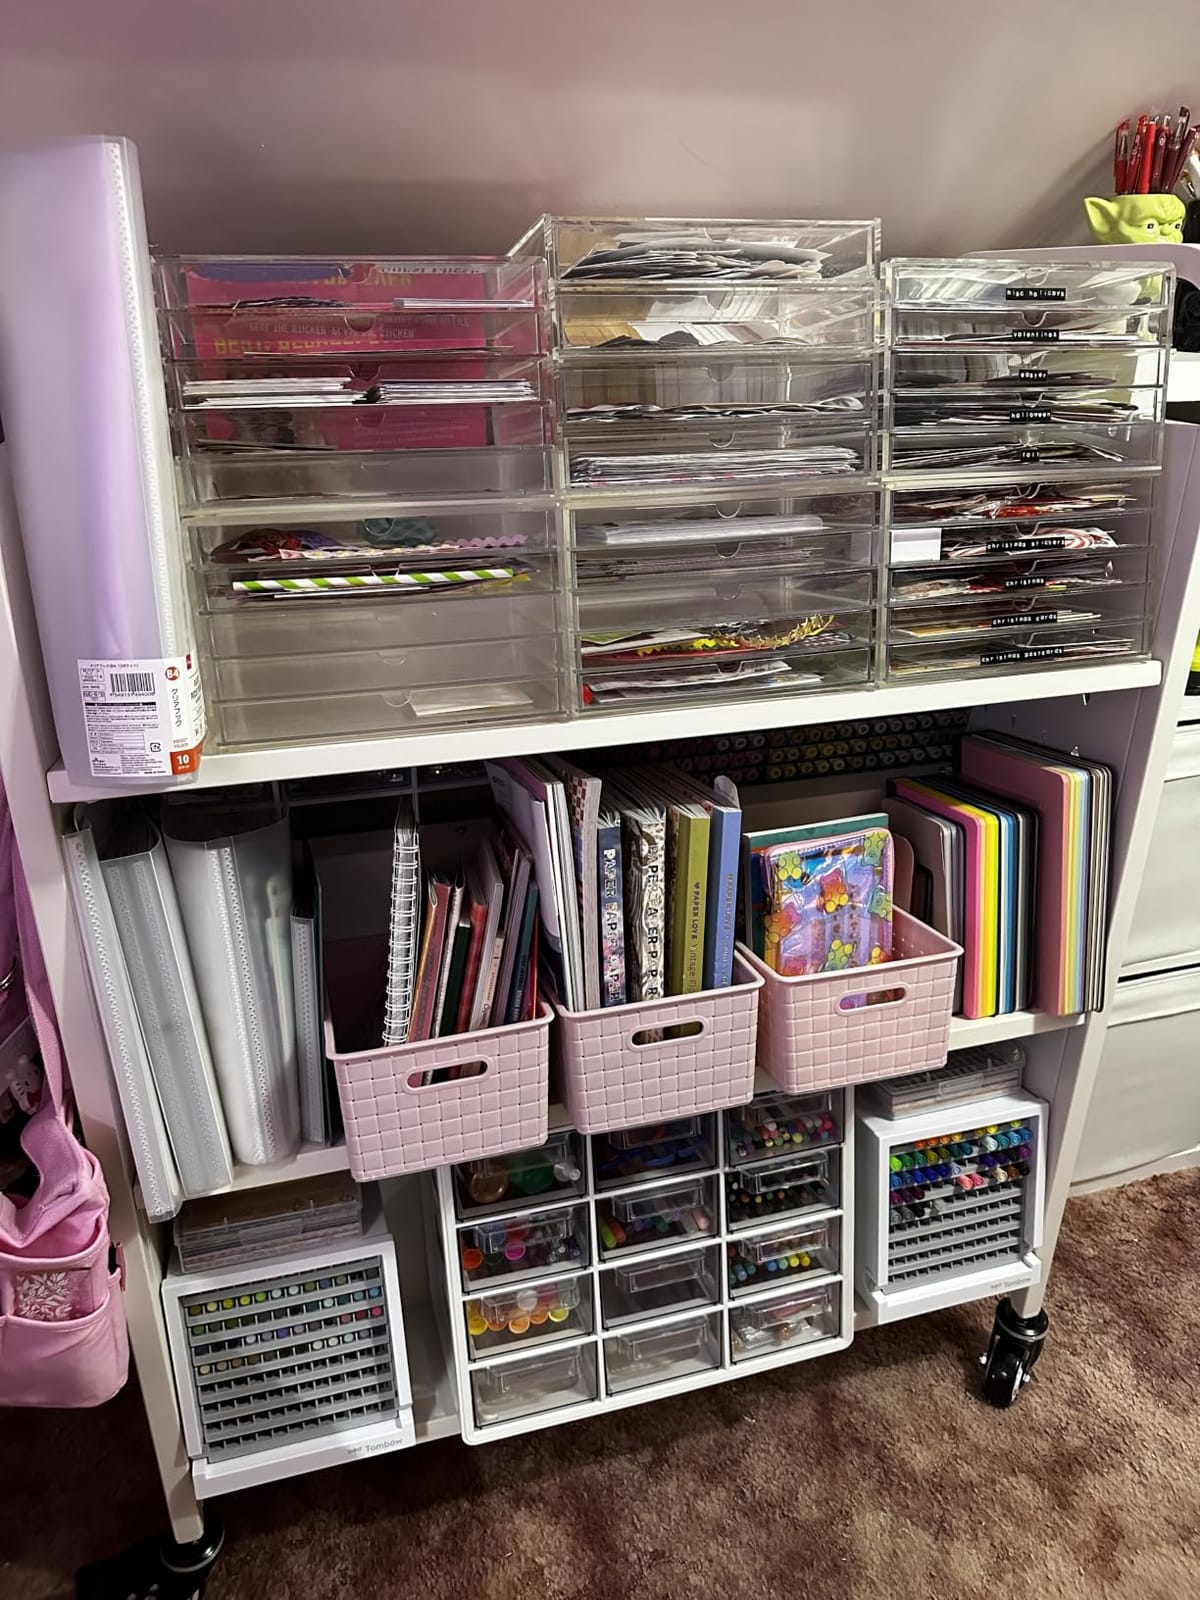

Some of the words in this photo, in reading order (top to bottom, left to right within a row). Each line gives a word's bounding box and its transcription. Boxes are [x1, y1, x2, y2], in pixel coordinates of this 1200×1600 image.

[987, 541, 1026, 549] christmas
[1005, 578, 1045, 586] christmas
[992, 616, 1032, 625] christmas
[981, 653, 1020, 662] christmas
[1024, 648, 1063, 658] postcards
[166, 669, 179, 679] B4
[171, 688, 183, 727] クリアブック
[177, 754, 190, 765] 10
[603, 849, 617, 897] PAPER
[691, 891, 701, 917] PAPER
[605, 903, 619, 950] PAPER
[690, 918, 700, 940] LOVE
[687, 943, 698, 977] Vintage
[365, 1438, 403, 1452] Tombow
